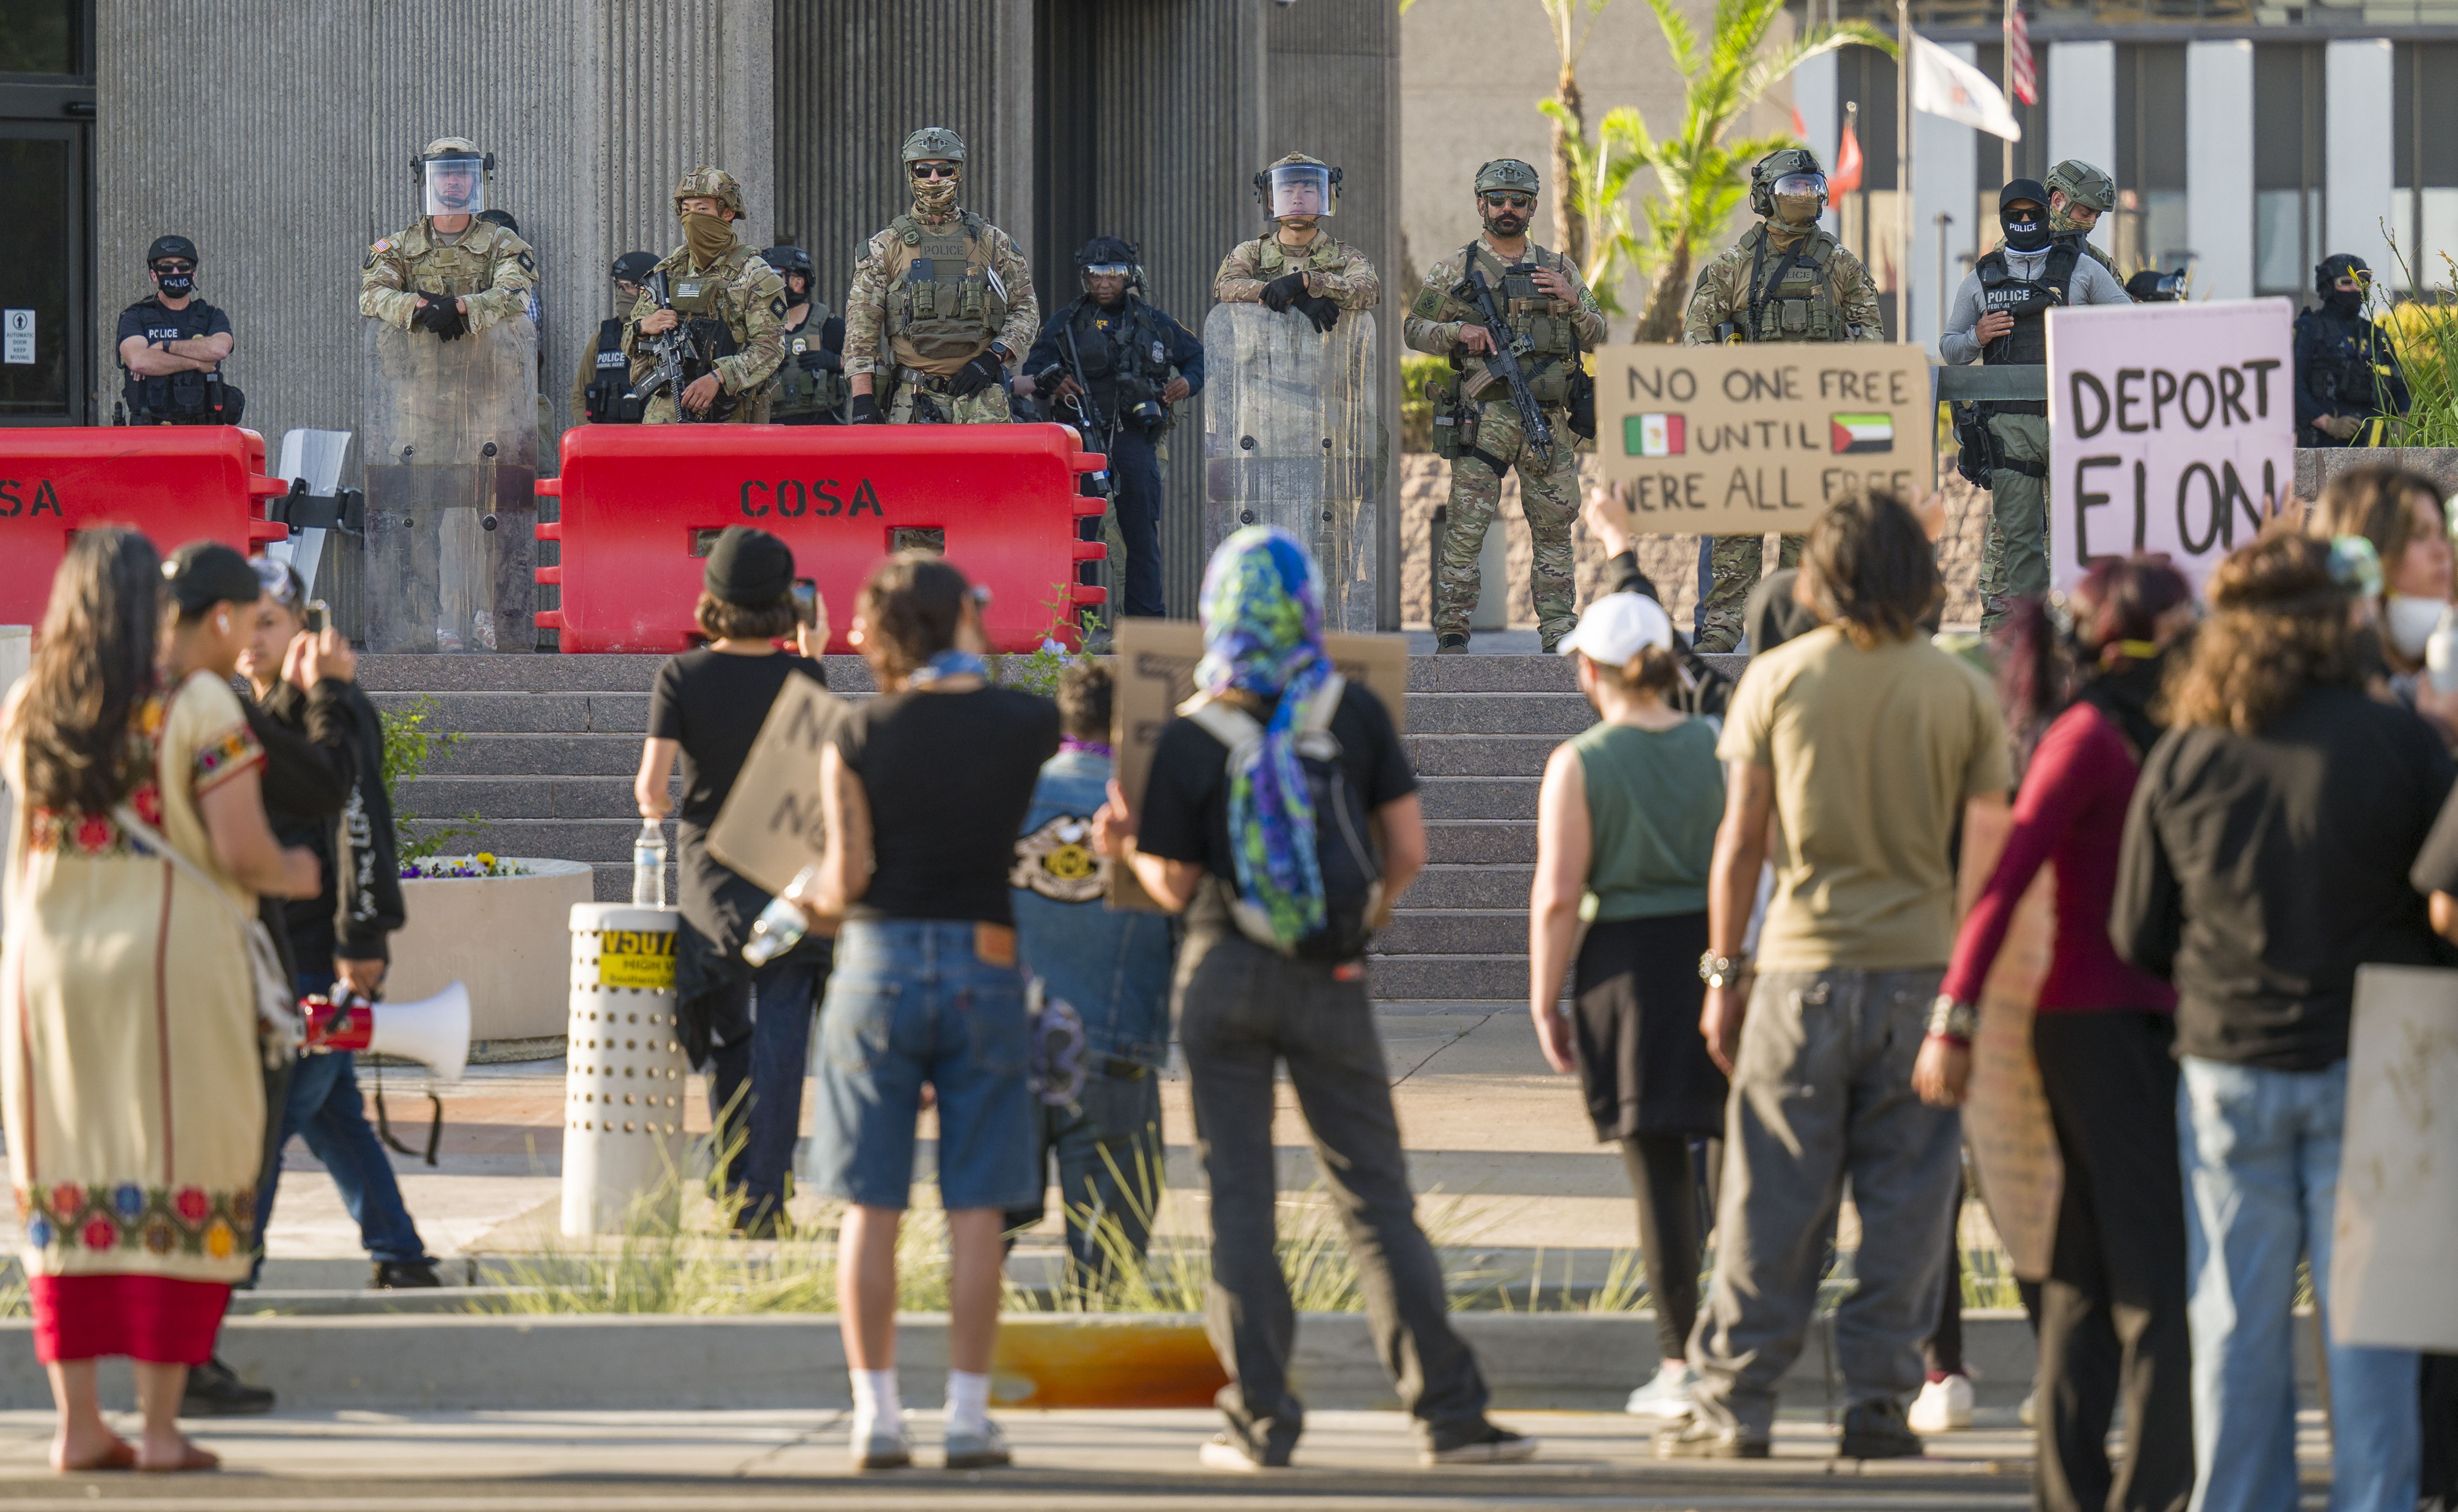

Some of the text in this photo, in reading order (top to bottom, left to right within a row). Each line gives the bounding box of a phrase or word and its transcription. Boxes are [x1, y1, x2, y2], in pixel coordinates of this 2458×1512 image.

[2009, 223, 2037, 232] POLICE
[924, 245, 964, 255] POLICE
[1429, 291, 1440, 299] ICE
[1988, 290, 2029, 303] POLICE
[149, 329, 178, 338] POLICE
[597, 352, 625, 363] POLICE
[971, 361, 988, 375] HARDY
[1628, 366, 1909, 405] NO ONE FREE
[2071, 359, 2281, 439] DEPORT
[1697, 420, 1819, 453] UNTIL
[1725, 466, 1805, 510] ALL
[740, 478, 884, 517] COSA
